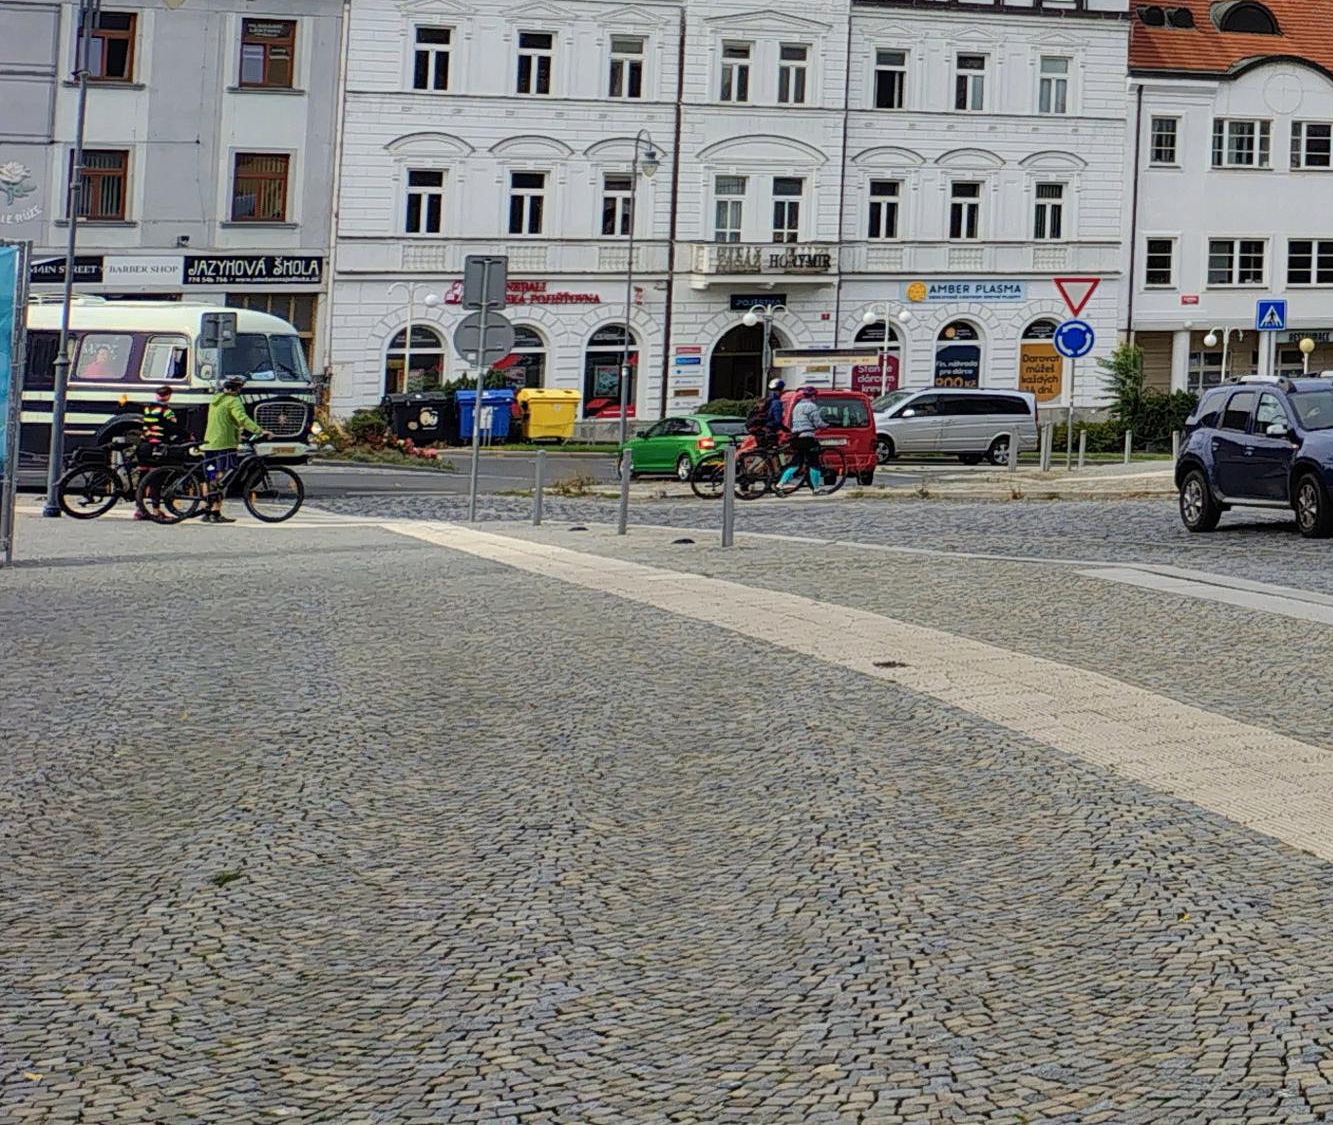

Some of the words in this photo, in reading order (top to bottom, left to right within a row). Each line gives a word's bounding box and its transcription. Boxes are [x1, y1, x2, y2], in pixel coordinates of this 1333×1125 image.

[58, 265, 98, 274] SREET
[150, 265, 178, 274] SHOP
[929, 284, 970, 294] AMBER
[975, 284, 1021, 294] PLASMA
